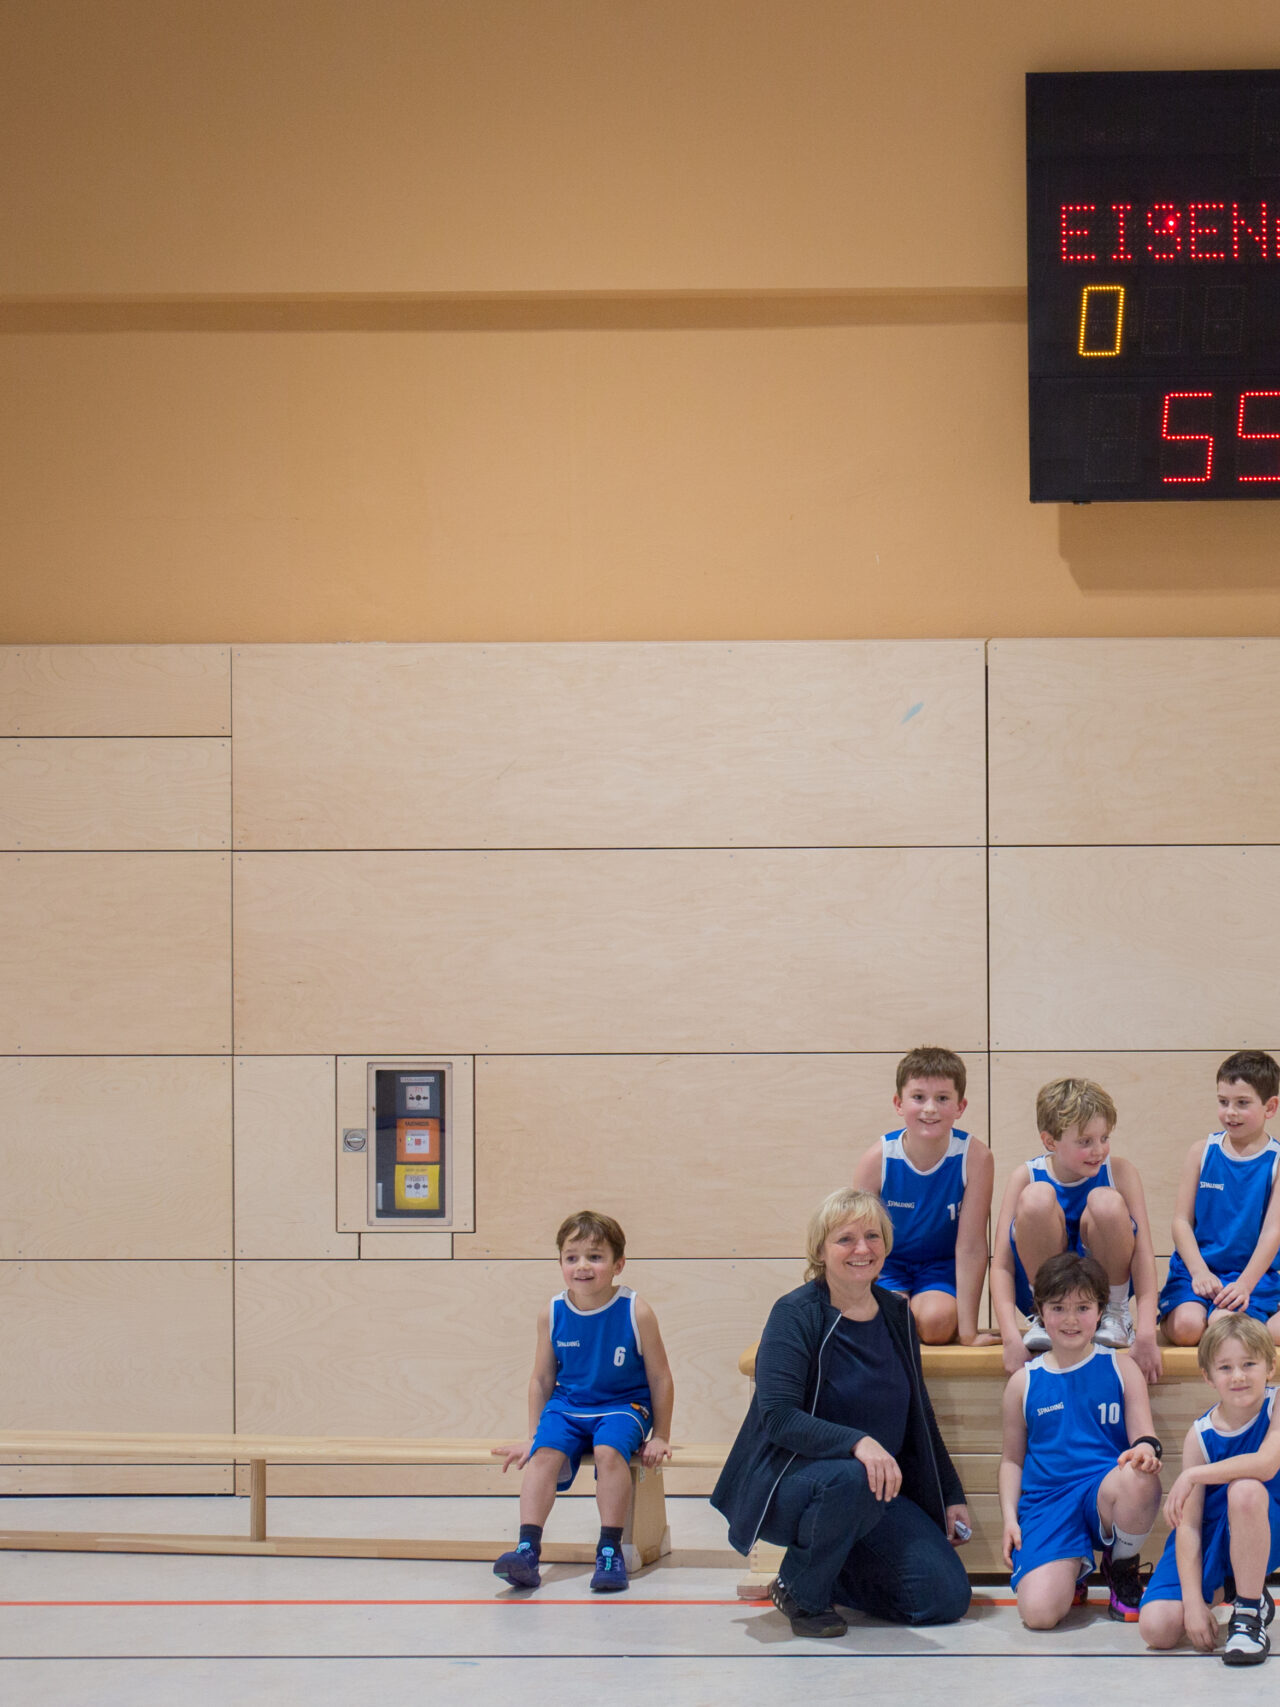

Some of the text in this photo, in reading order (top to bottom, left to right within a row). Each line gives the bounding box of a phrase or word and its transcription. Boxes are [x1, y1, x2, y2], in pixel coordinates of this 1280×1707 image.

[1078, 284, 1126, 357] 0
[613, 1346, 627, 1367] 6
[1036, 1401, 1065, 1417] SPALDING
[1097, 1402, 1121, 1425] 10
